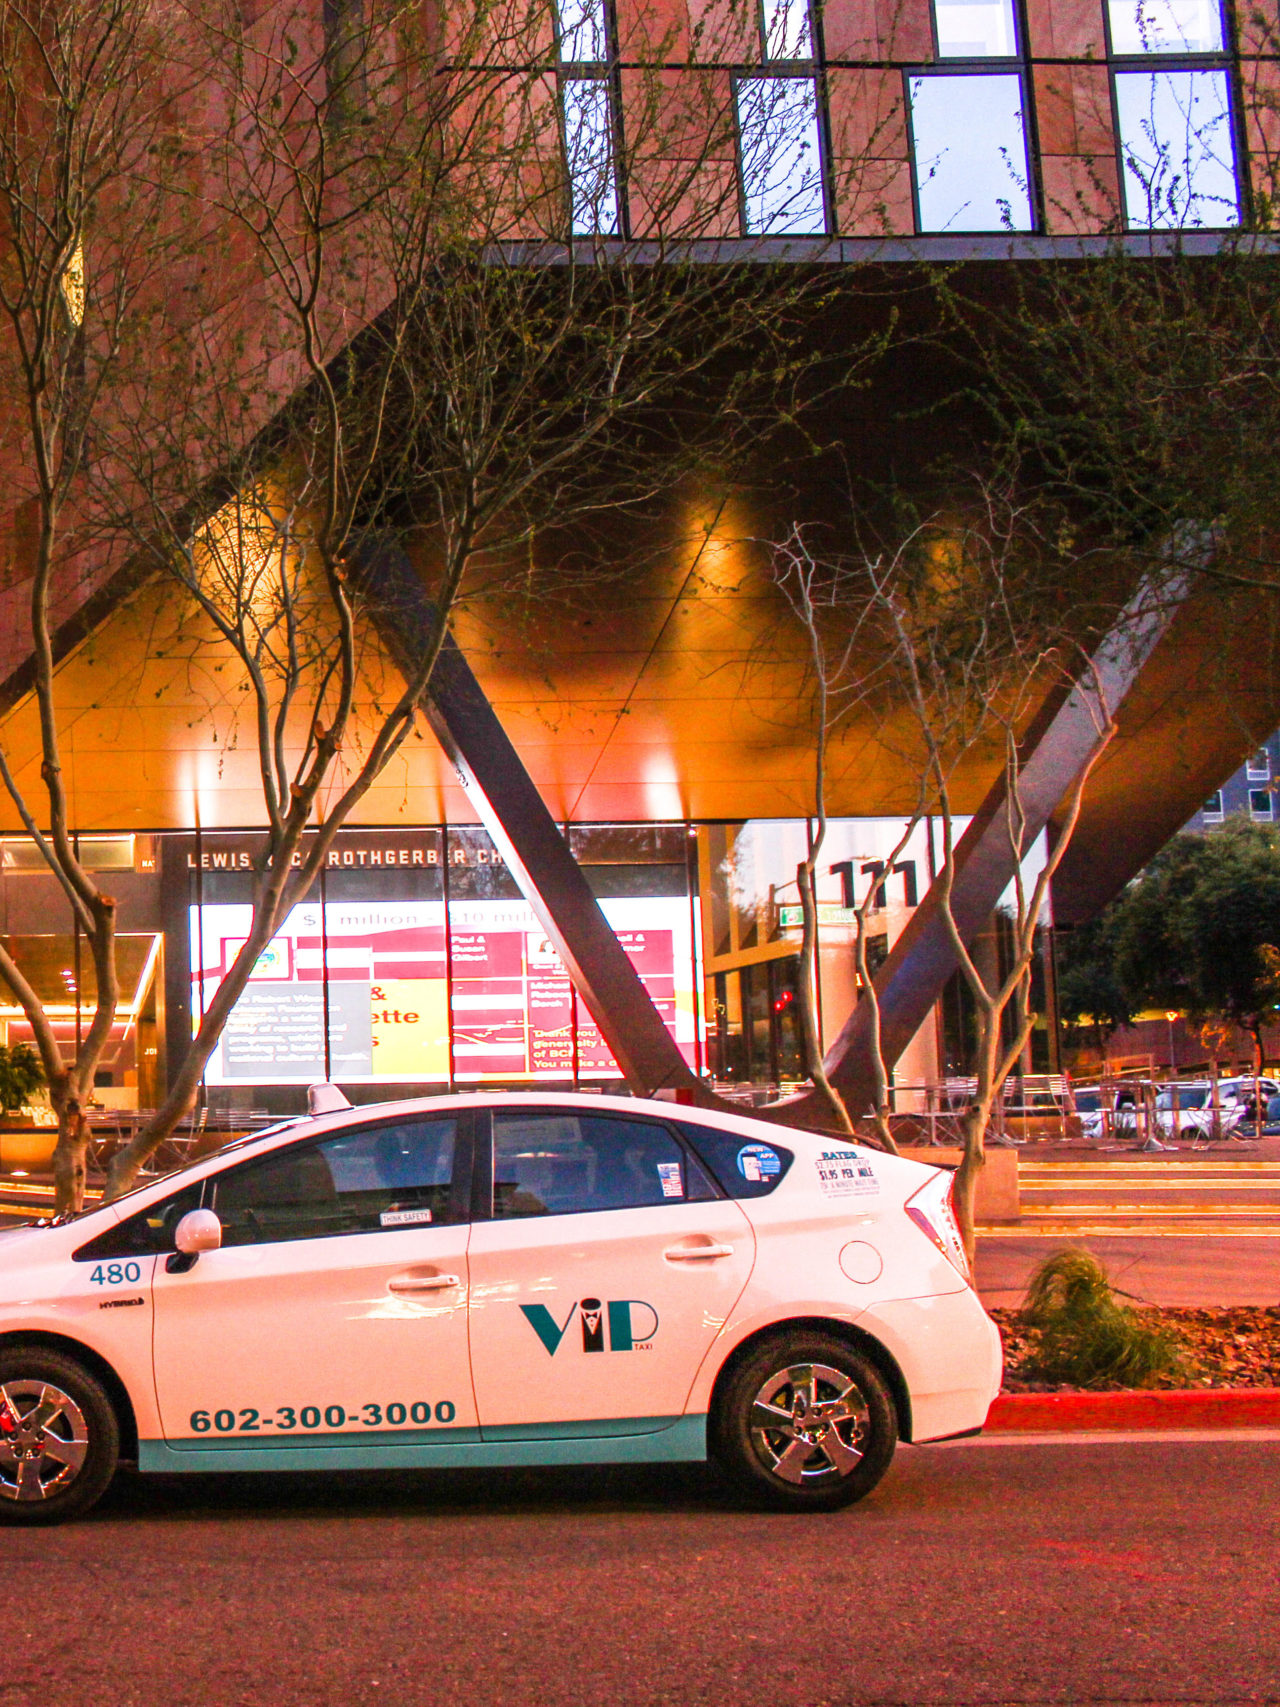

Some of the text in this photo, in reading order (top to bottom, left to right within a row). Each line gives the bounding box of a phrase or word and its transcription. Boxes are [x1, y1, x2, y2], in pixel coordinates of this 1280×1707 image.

[187, 851, 251, 868] LEWIS
[829, 859, 918, 909] 111
[339, 911, 418, 926] million
[371, 1009, 420, 1024] ette
[533, 1030, 570, 1038] Thank
[533, 1049, 547, 1058] of
[533, 1060, 557, 1068] You
[560, 1059, 595, 1068] mke
[821, 1150, 858, 1161] RATES
[382, 1212, 428, 1224] THINK SAFETY
[89, 1261, 141, 1286] 480
[634, 1343, 653, 1351] TAXI
[189, 1399, 457, 1434] 602-300-3000
